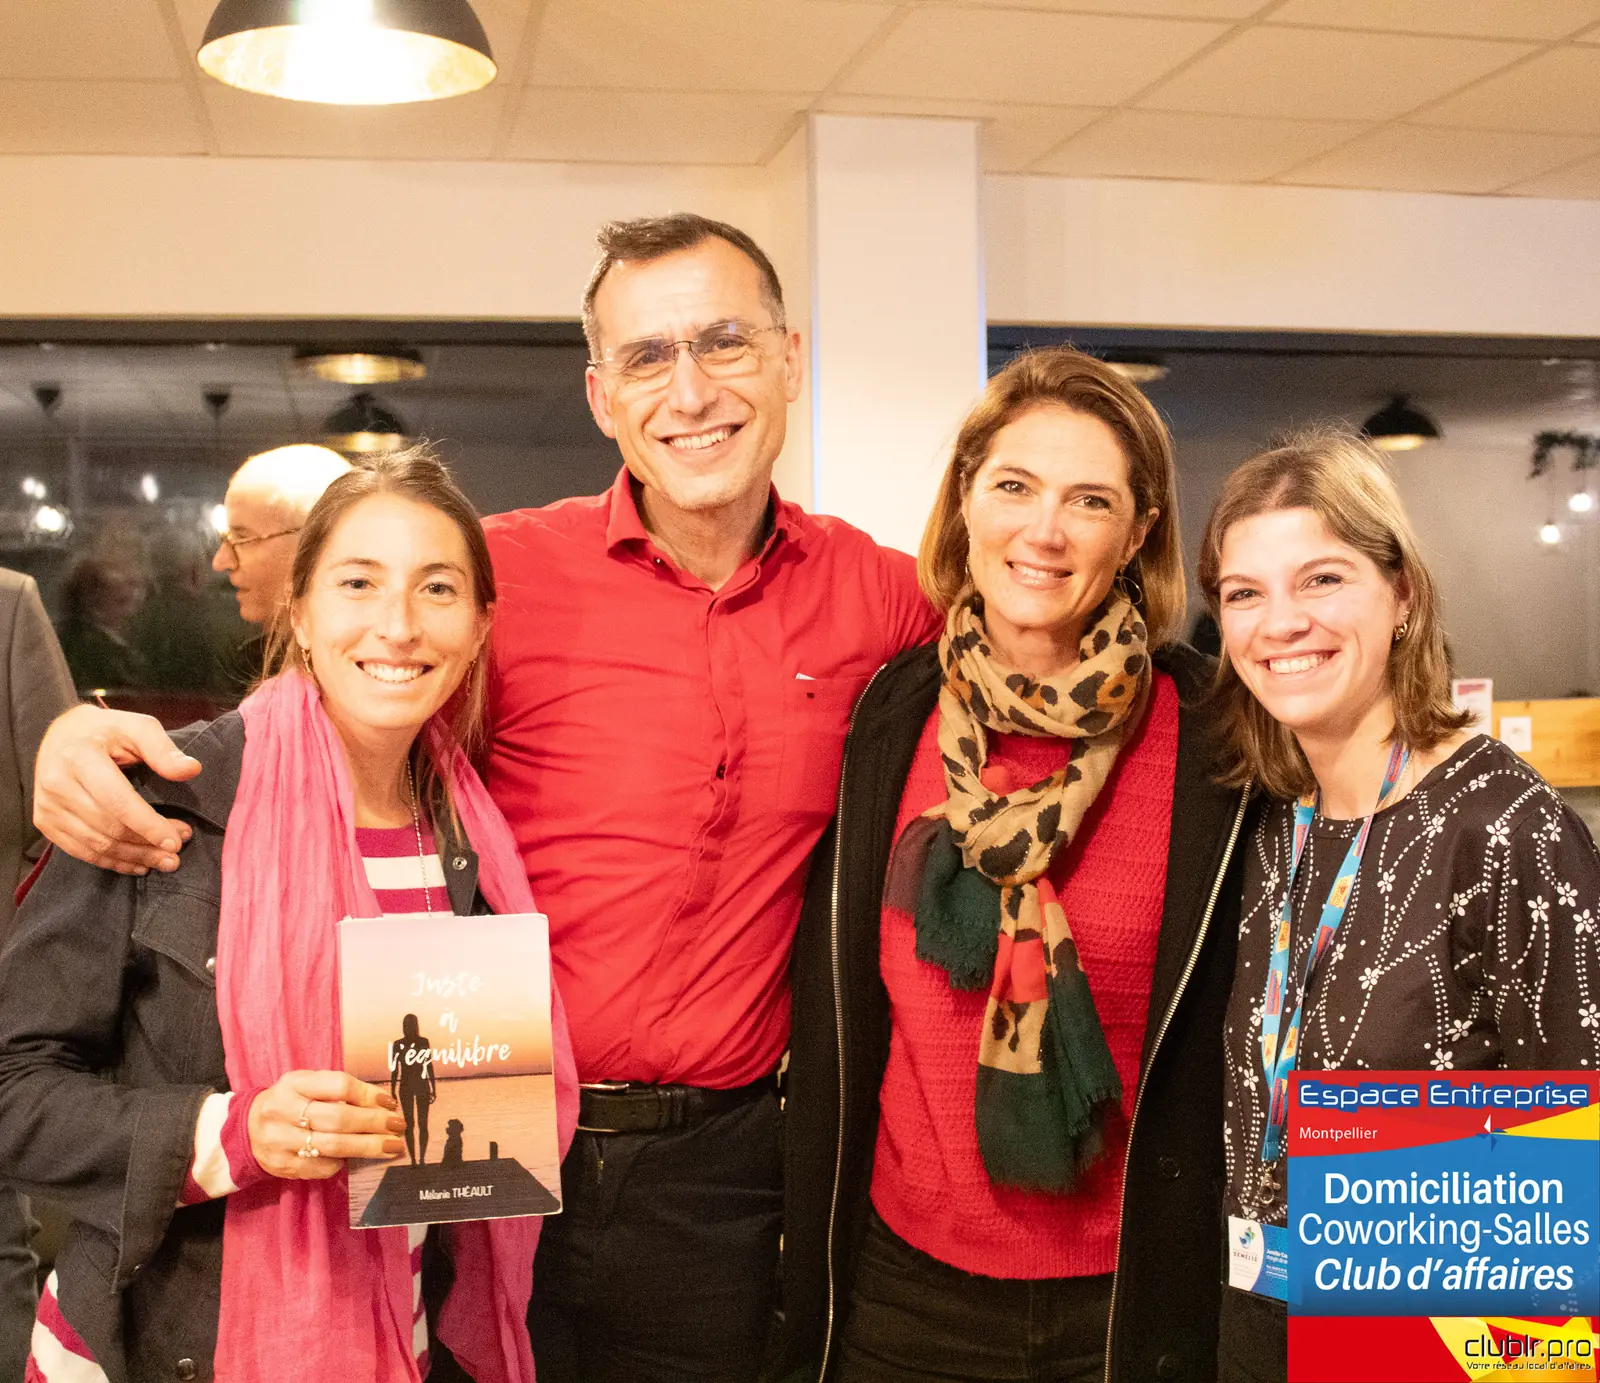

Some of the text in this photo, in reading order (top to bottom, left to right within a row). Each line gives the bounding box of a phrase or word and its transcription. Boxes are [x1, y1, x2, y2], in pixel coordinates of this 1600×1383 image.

[411, 970, 484, 999] Juste
[387, 1034, 512, 1079] l'équilibre
[419, 1184, 494, 1201] Mélanie THÉAULT
